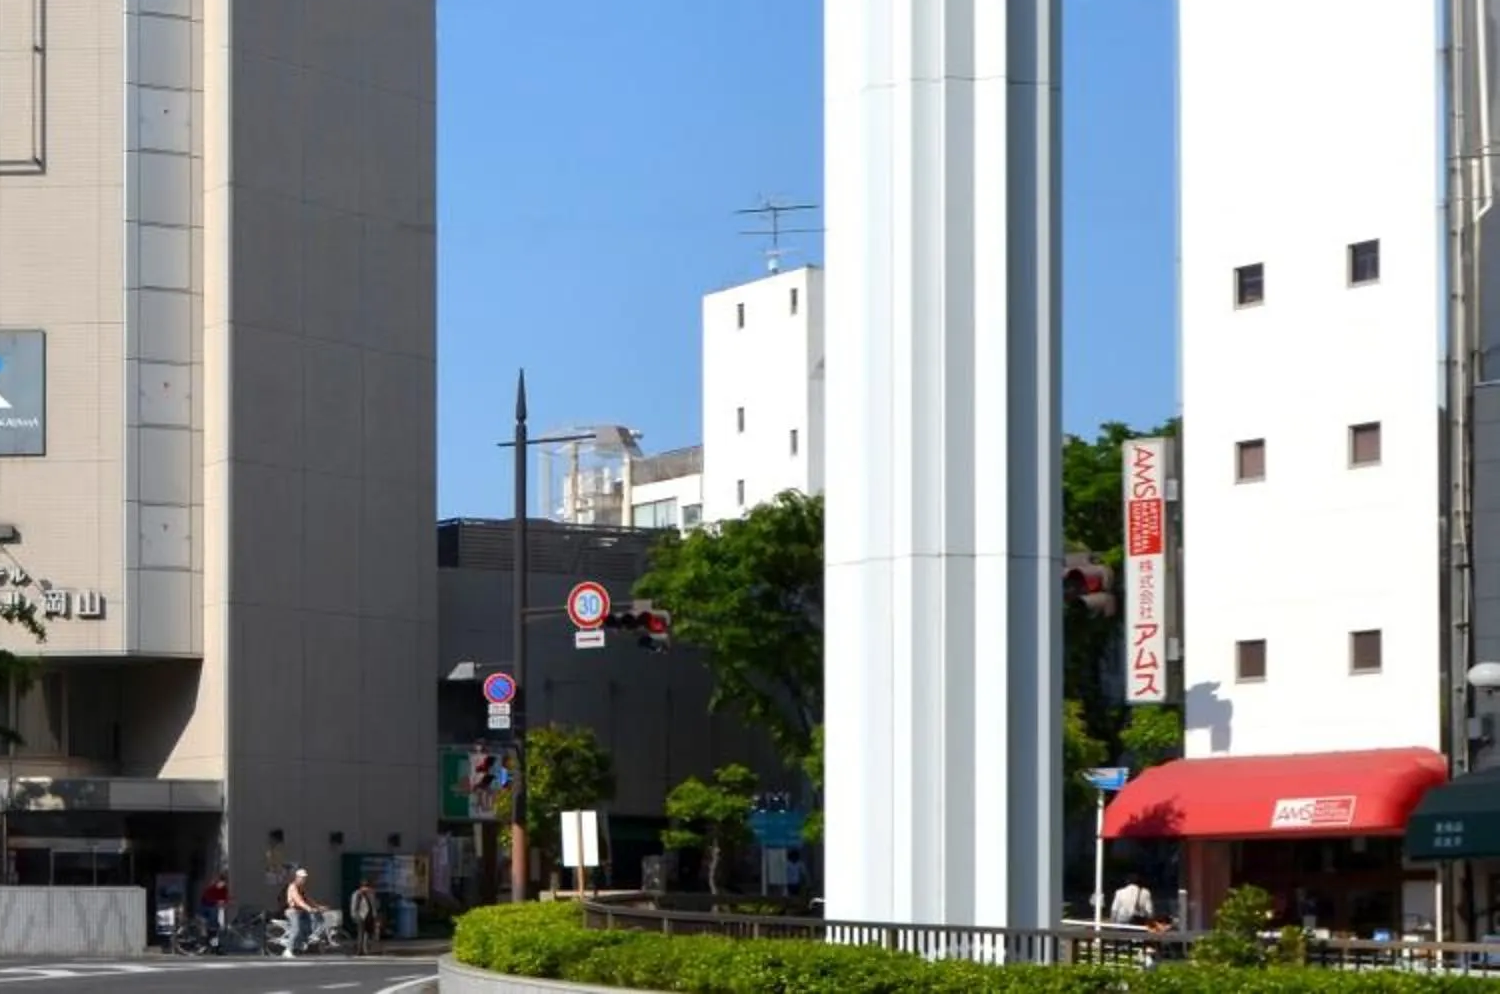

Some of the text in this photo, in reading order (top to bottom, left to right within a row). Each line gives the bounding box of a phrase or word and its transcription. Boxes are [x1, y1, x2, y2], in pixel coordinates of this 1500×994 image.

[1133, 445, 1157, 499] AMS
[579, 593, 601, 615] 30
[1133, 623, 1160, 696] アムス
